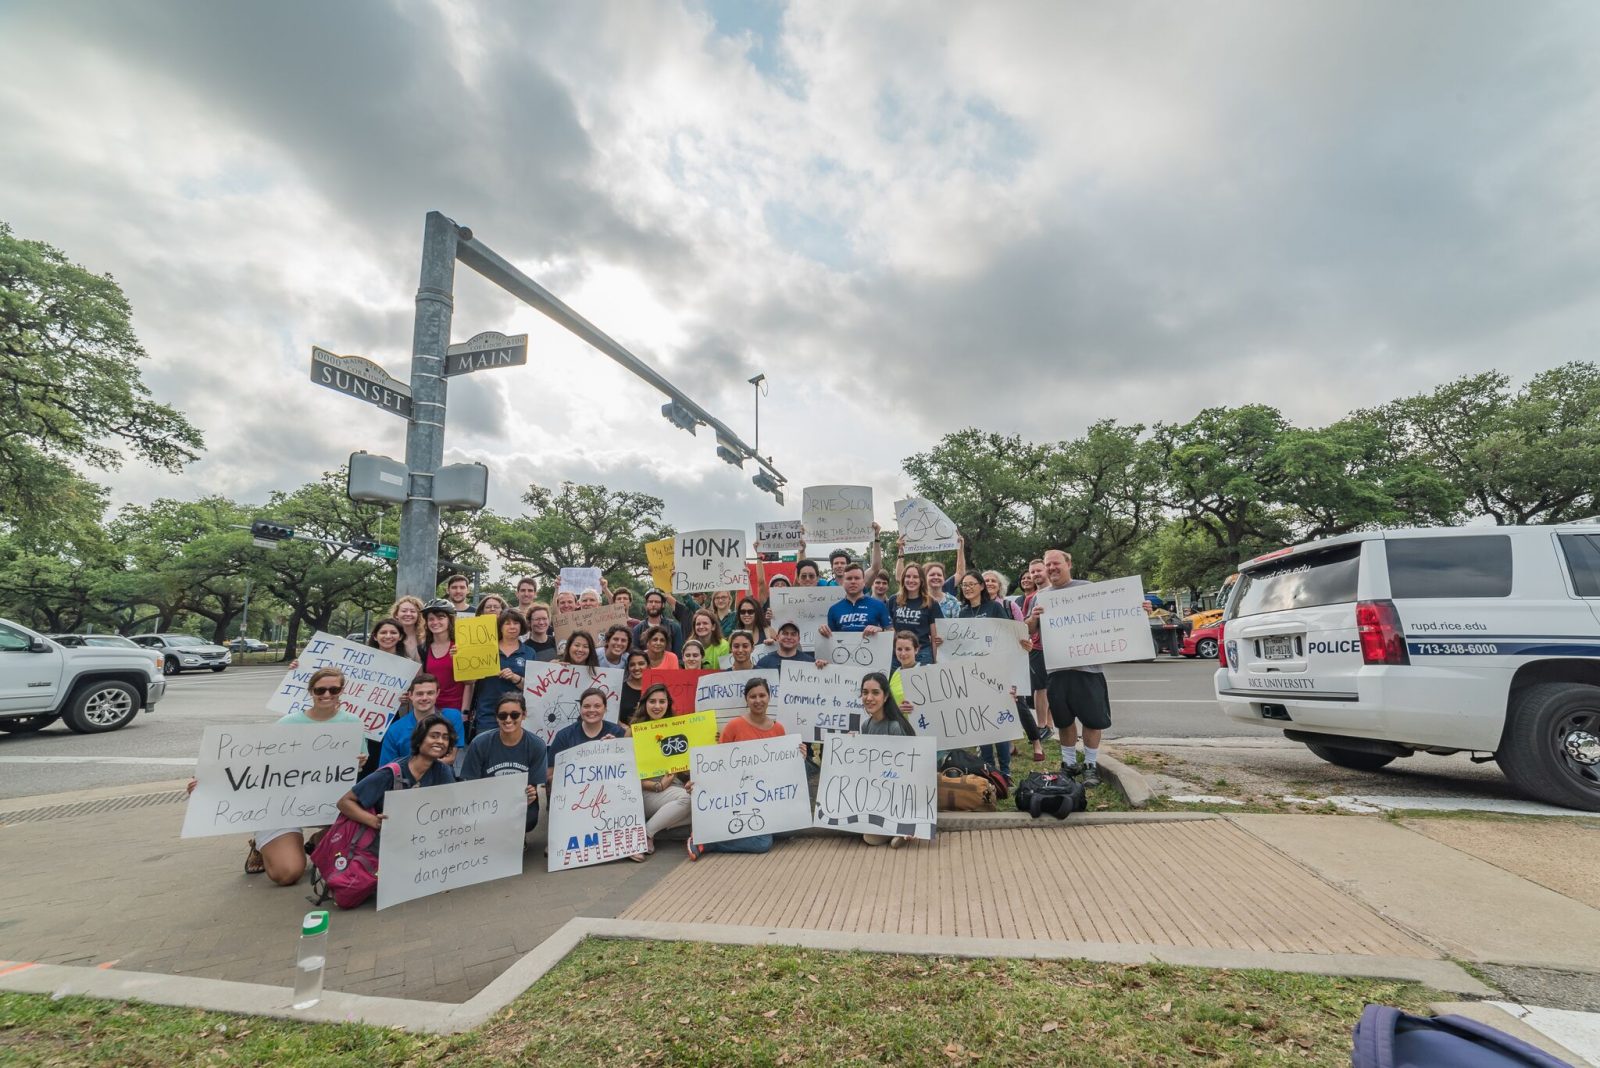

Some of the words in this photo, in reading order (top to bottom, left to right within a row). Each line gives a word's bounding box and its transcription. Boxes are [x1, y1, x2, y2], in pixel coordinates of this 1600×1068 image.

[458, 349, 512, 371] MAIN
[321, 366, 405, 411] SUNSET
[837, 487, 873, 512] SLOW
[785, 531, 802, 540] OUT
[681, 538, 740, 558] HONK
[702, 558, 713, 571] IF
[723, 569, 748, 586] SAFE
[839, 612, 868, 624] RICE
[1049, 611, 1097, 630] ROMAINE
[1101, 606, 1142, 621] LETTUCE
[1411, 621, 1488, 632] rupd.rice.edu
[457, 624, 497, 646] SLOW
[946, 622, 981, 641] Bike
[307, 640, 335, 655] IF
[343, 647, 375, 666] THIS
[1068, 638, 1128, 658] RECALLED
[1308, 640, 1361, 655] POLICE
[1417, 643, 1498, 655] 713-348-6000
[456, 653, 498, 671] DOWN
[291, 669, 313, 684] WE
[342, 682, 365, 699] LUE
[526, 667, 581, 697] Watch
[787, 667, 820, 684] When
[824, 673, 841, 685] will
[844, 679, 858, 689] my
[910, 665, 968, 706] SLOW
[971, 661, 1004, 692] down
[1248, 678, 1262, 688] RICE
[1264, 678, 1315, 690] UNIVERSITY
[783, 693, 827, 705] commute
[832, 695, 841, 707] to
[796, 711, 807, 727] be
[815, 712, 847, 728] SAFE
[940, 704, 1000, 738] LOOK
[217, 733, 302, 761] Protect
[311, 733, 351, 752] Our
[615, 742, 626, 754] be
[830, 737, 921, 773] Respect
[696, 752, 728, 775] POOR
[729, 746, 760, 769] GRAD
[760, 743, 801, 763] STUDENT
[224, 764, 357, 792] Vulnerable
[563, 763, 628, 787] RISKING
[881, 768, 900, 780] the
[571, 783, 612, 818] Life
[697, 790, 749, 812] CYCLIST
[753, 779, 799, 803] SAFETY
[825, 775, 936, 820] CROSSWALK
[214, 796, 270, 826] Road
[280, 796, 339, 818] Users
[416, 799, 498, 826] Commuting
[594, 810, 642, 831] SCHOOL
[410, 834, 426, 845] to
[437, 820, 477, 840] school
[418, 839, 469, 860] shouldn't
[473, 837, 486, 846] be
[563, 826, 648, 866] AMERICA
[414, 854, 489, 884] dangerous
